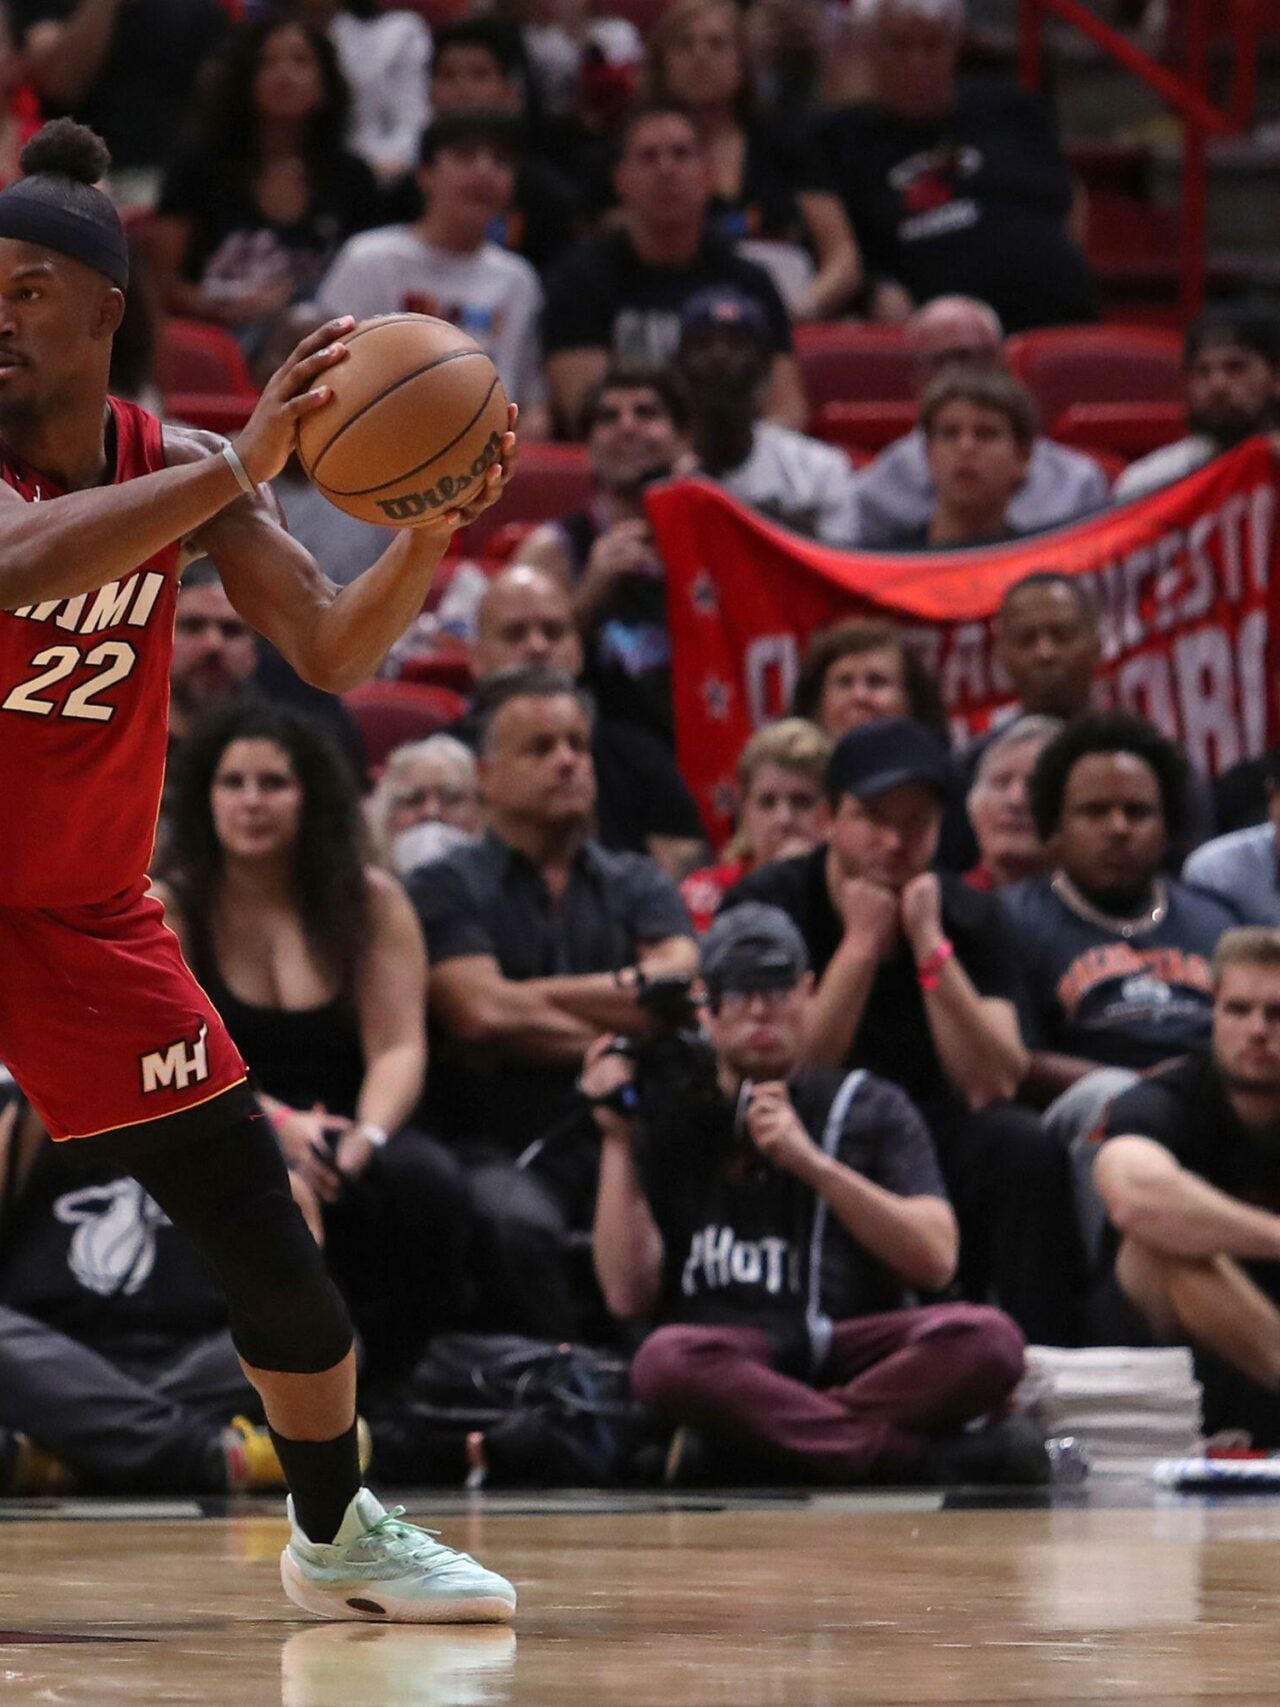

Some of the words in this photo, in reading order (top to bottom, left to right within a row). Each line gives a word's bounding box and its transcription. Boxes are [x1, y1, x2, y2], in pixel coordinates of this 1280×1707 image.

[375, 430, 502, 520] Wilson
[1, 640, 137, 722] 22
[140, 1022, 209, 1094] MH
